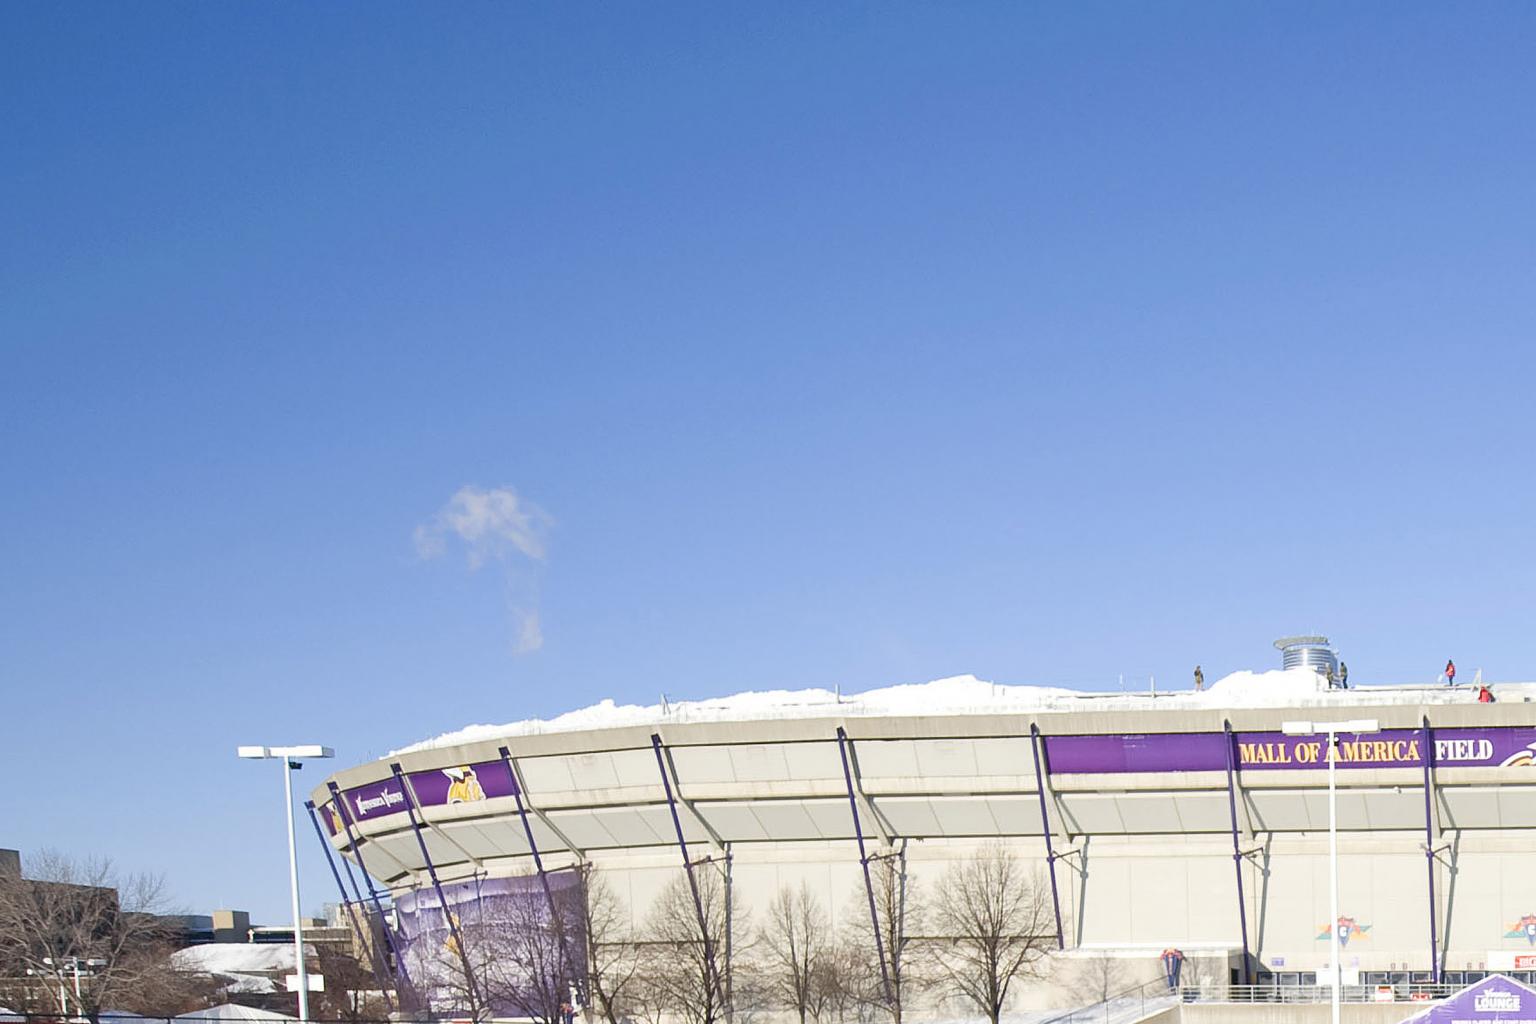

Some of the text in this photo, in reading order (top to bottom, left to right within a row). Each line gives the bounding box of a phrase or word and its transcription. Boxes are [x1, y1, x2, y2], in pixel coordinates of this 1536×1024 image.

[1239, 739, 1494, 764] MALL OF AMERICA FIELD
[1474, 997, 1520, 1009] LOUNGE
